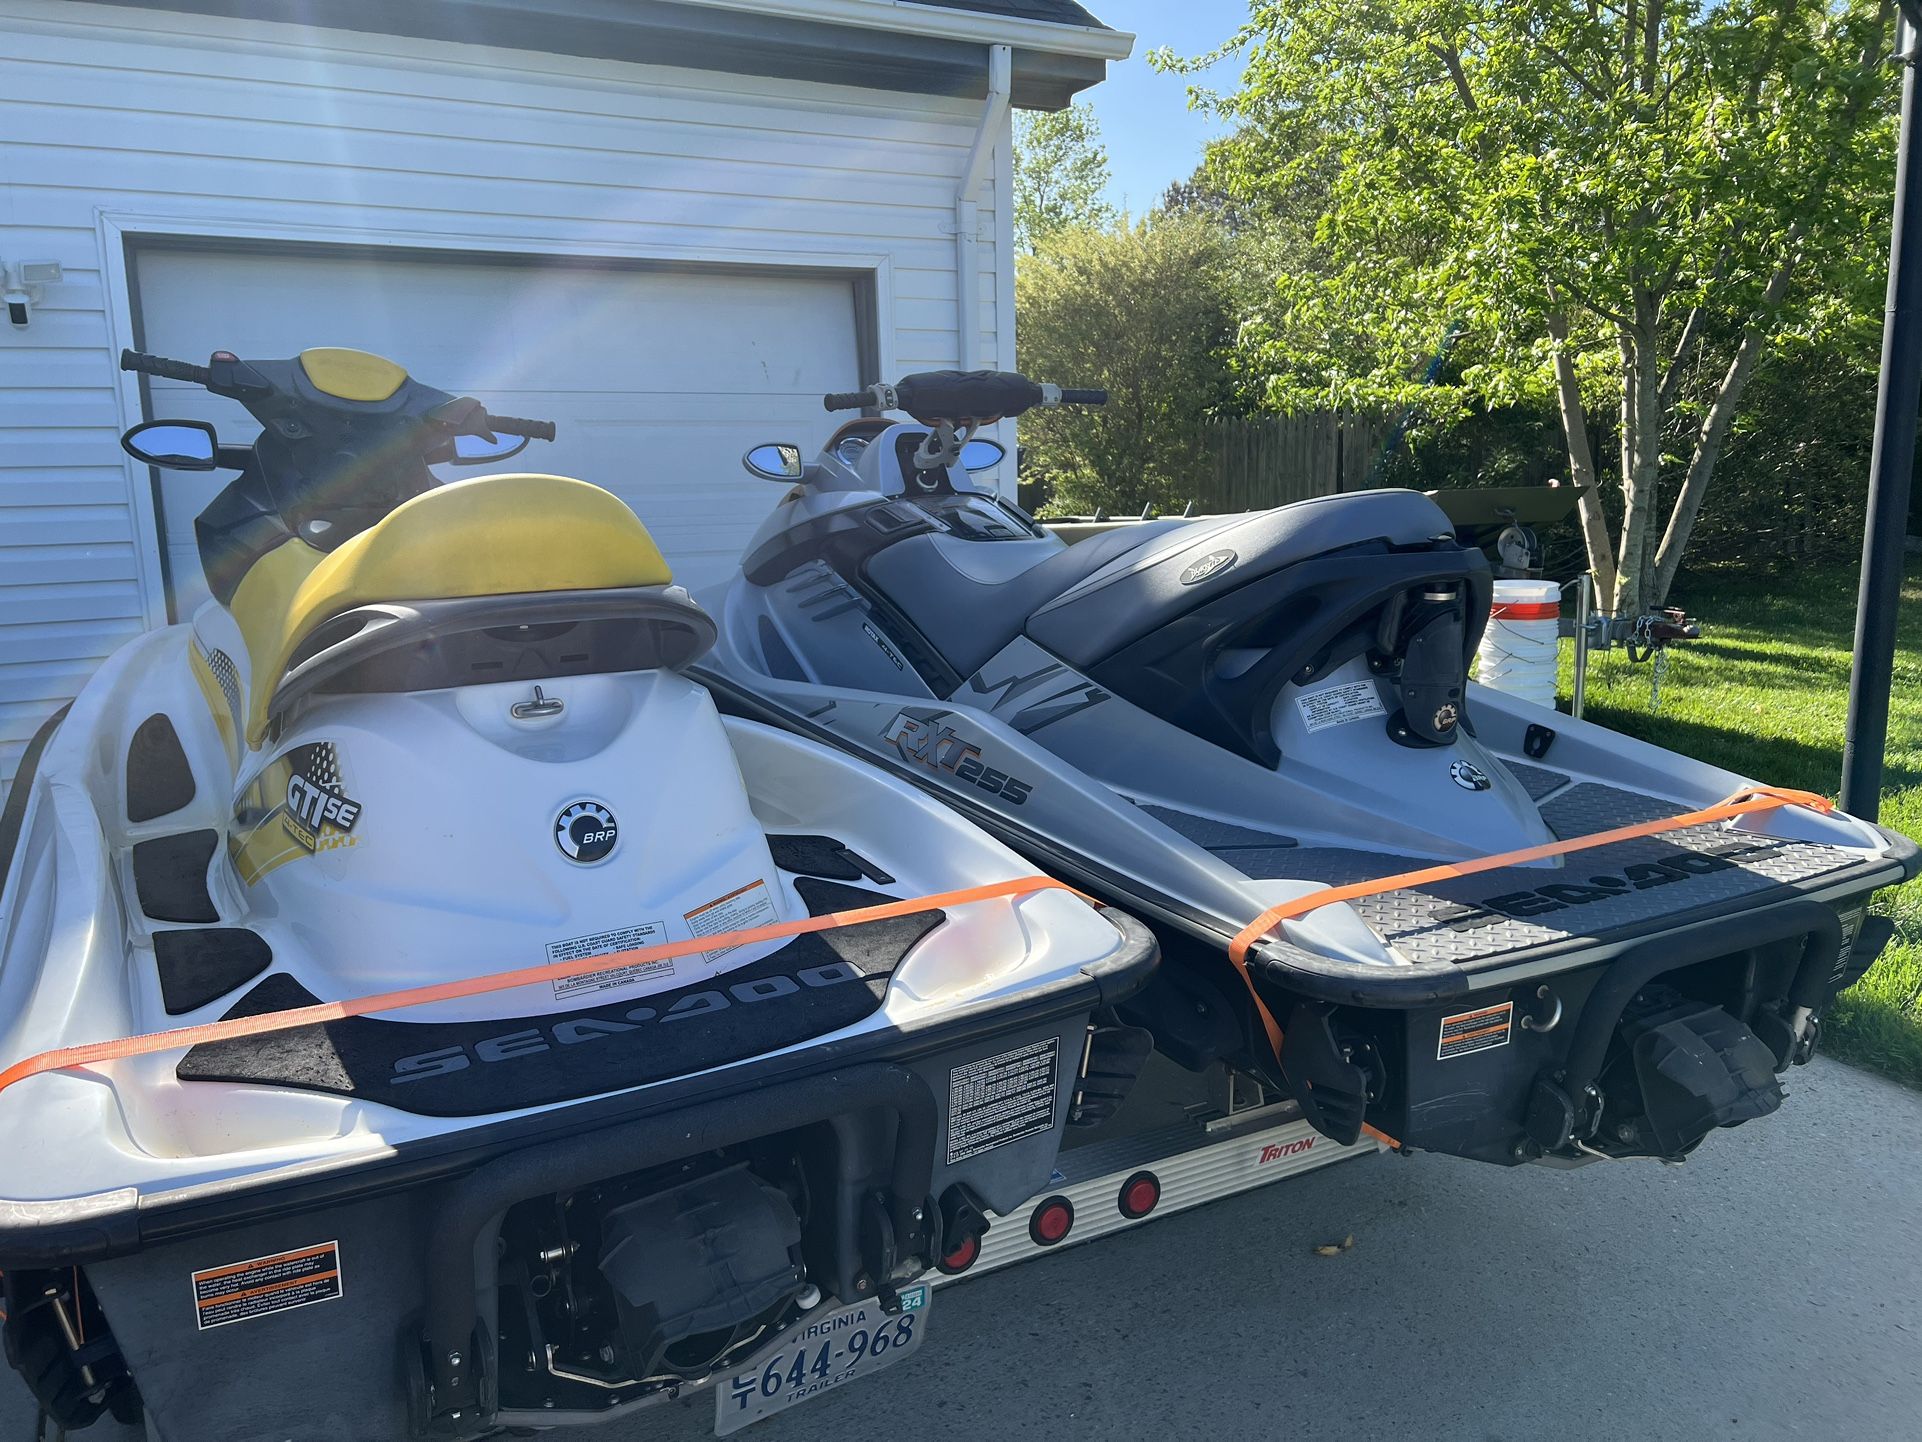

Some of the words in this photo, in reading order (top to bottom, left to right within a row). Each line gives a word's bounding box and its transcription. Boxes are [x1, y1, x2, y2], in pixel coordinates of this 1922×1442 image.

[884, 713, 982, 773] RXT
[955, 757, 1034, 805] 255
[287, 774, 329, 828] GTI
[323, 797, 359, 828] SE
[583, 830, 615, 844] BRP
[902, 1297, 921, 1310] 24
[787, 1368, 857, 1402] TRAILER
